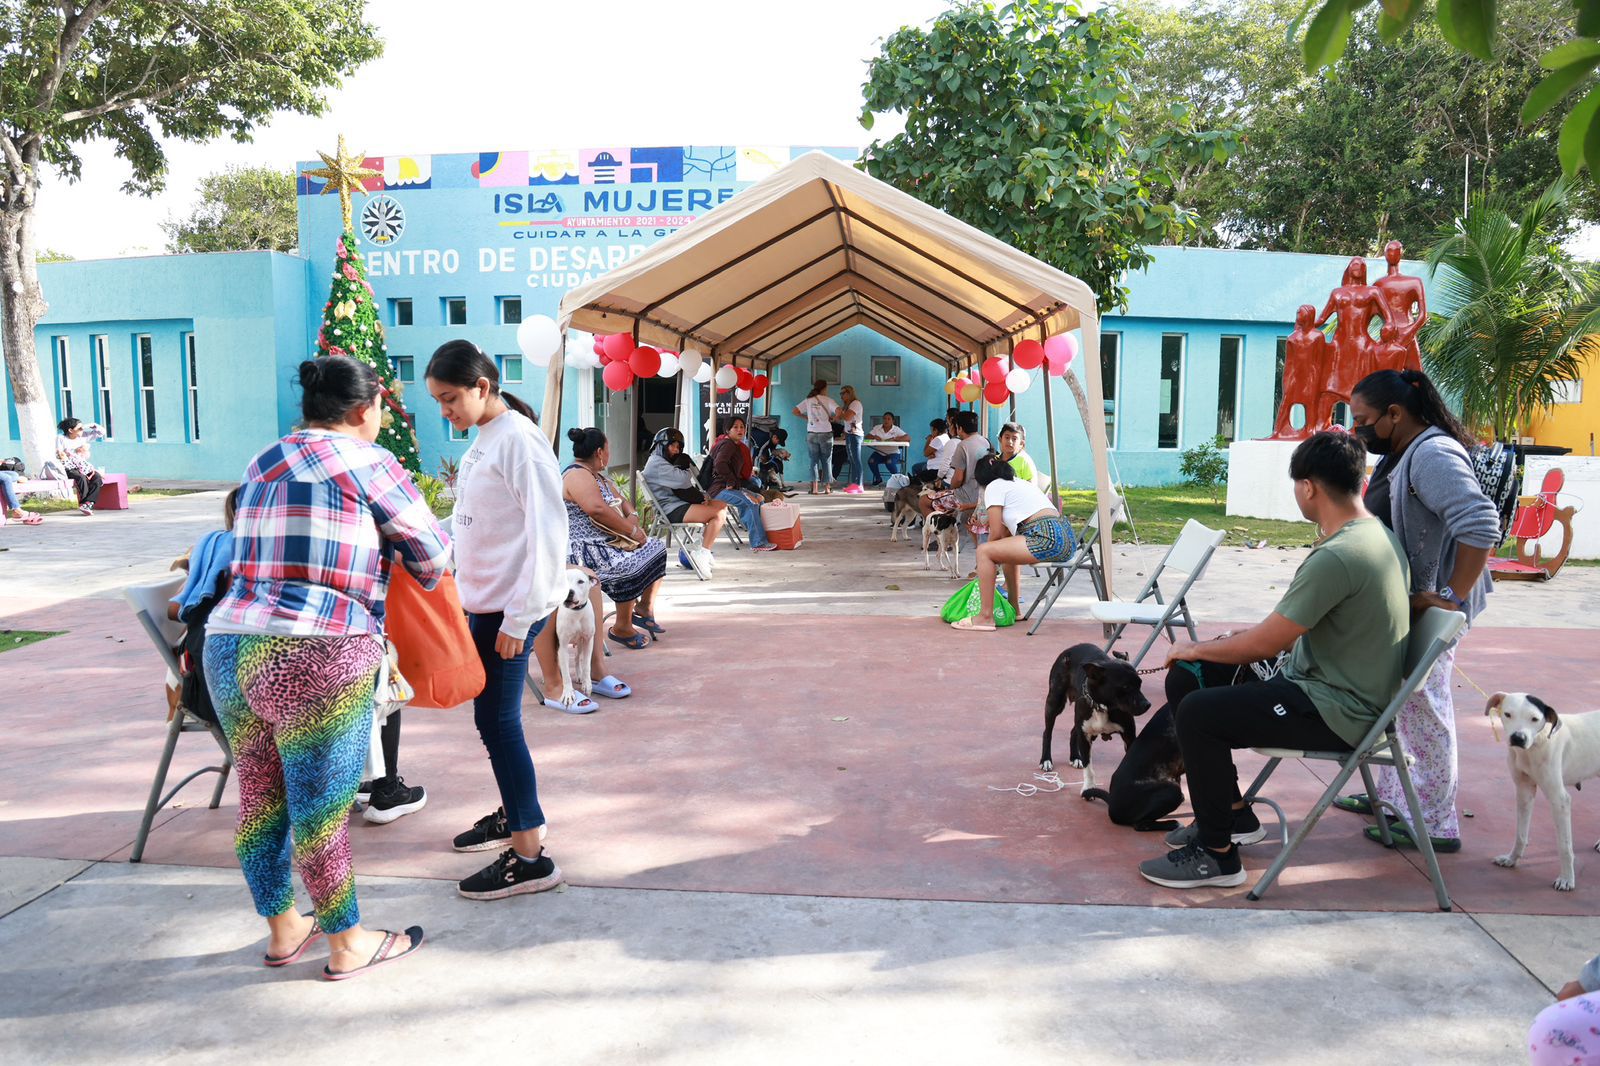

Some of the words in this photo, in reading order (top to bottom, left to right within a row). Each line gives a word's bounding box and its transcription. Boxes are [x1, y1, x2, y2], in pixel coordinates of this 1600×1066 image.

[494, 192, 563, 214] ISLA
[584, 189, 737, 213] MUJERE
[566, 217, 631, 227] AYUNTAMIENTO
[636, 216, 657, 226] 2021
[666, 214, 692, 225] 2024
[513, 230, 586, 239] CUIDAR
[596, 229, 607, 238] A
[618, 229, 643, 238] LA
[362, 248, 460, 278] ENTRO
[478, 247, 516, 273] DE
[527, 272, 606, 288] CIUDA
